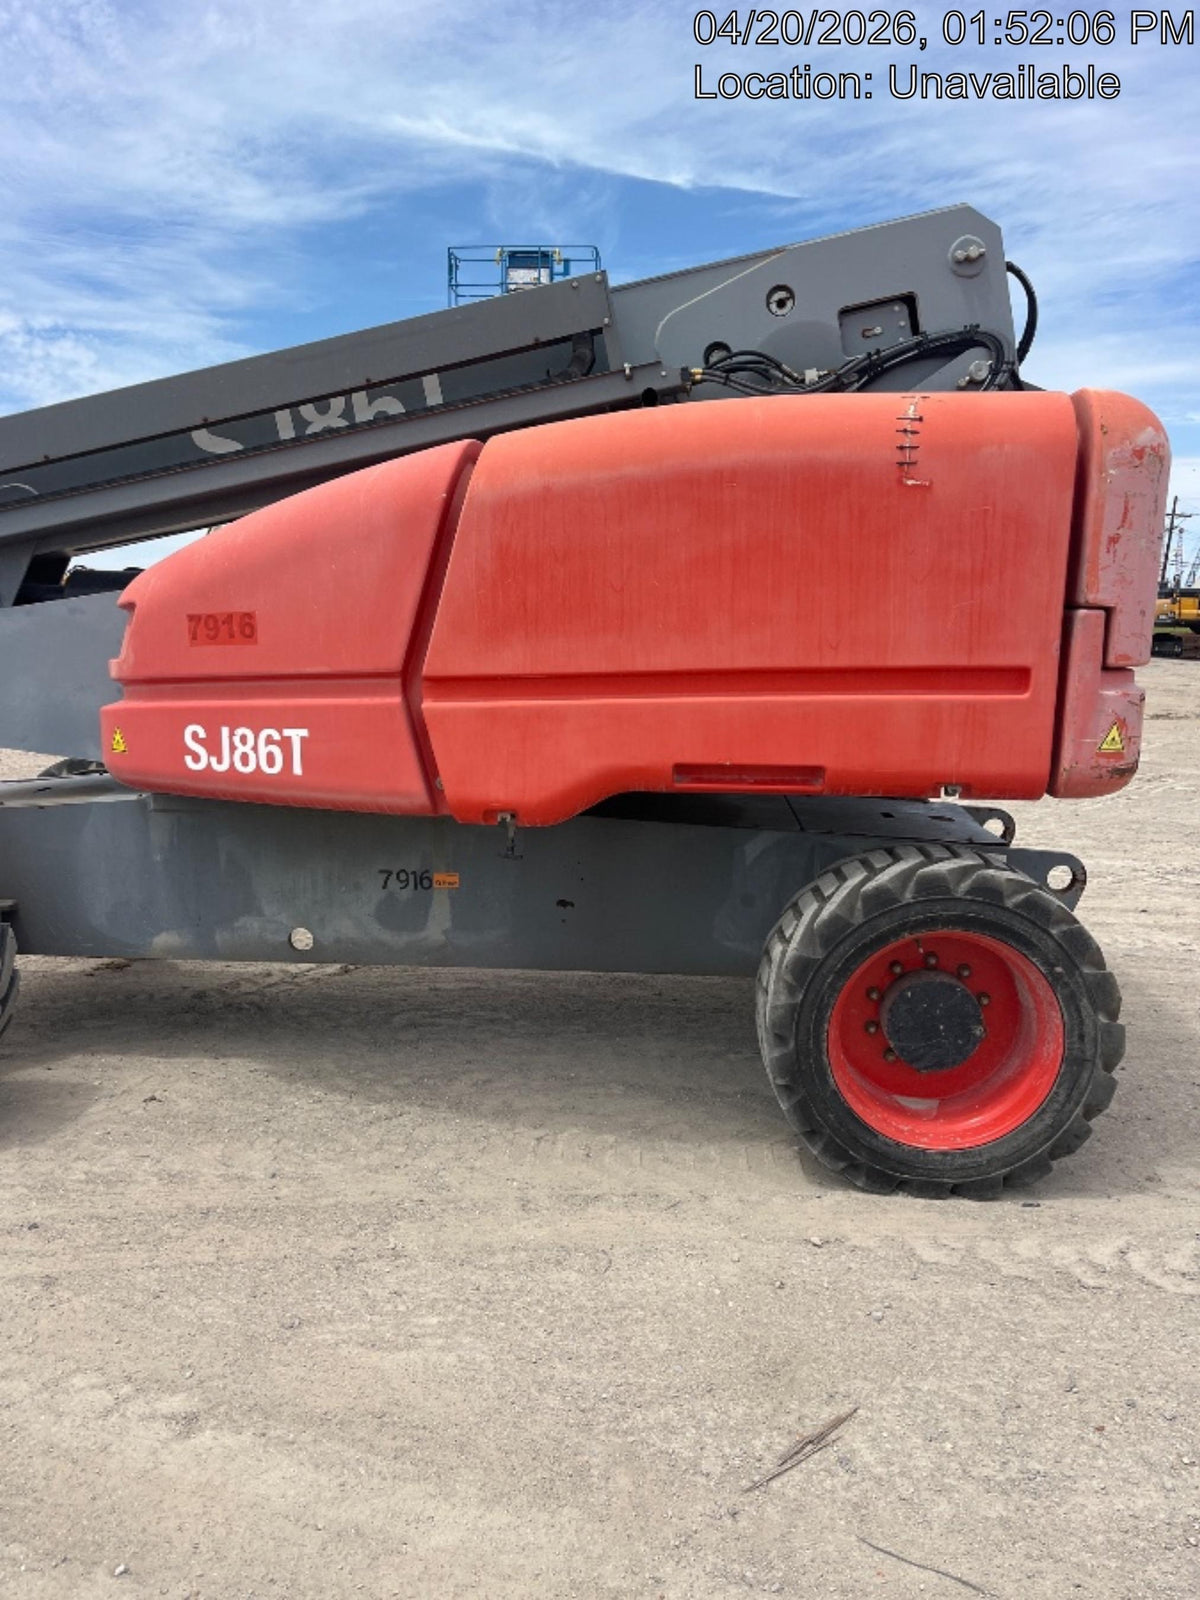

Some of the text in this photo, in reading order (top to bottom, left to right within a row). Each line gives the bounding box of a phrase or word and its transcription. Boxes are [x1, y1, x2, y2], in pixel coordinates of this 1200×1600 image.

[187, 613, 255, 641] 7916
[183, 724, 309, 775] SJ86T
[378, 869, 433, 891] 7916
